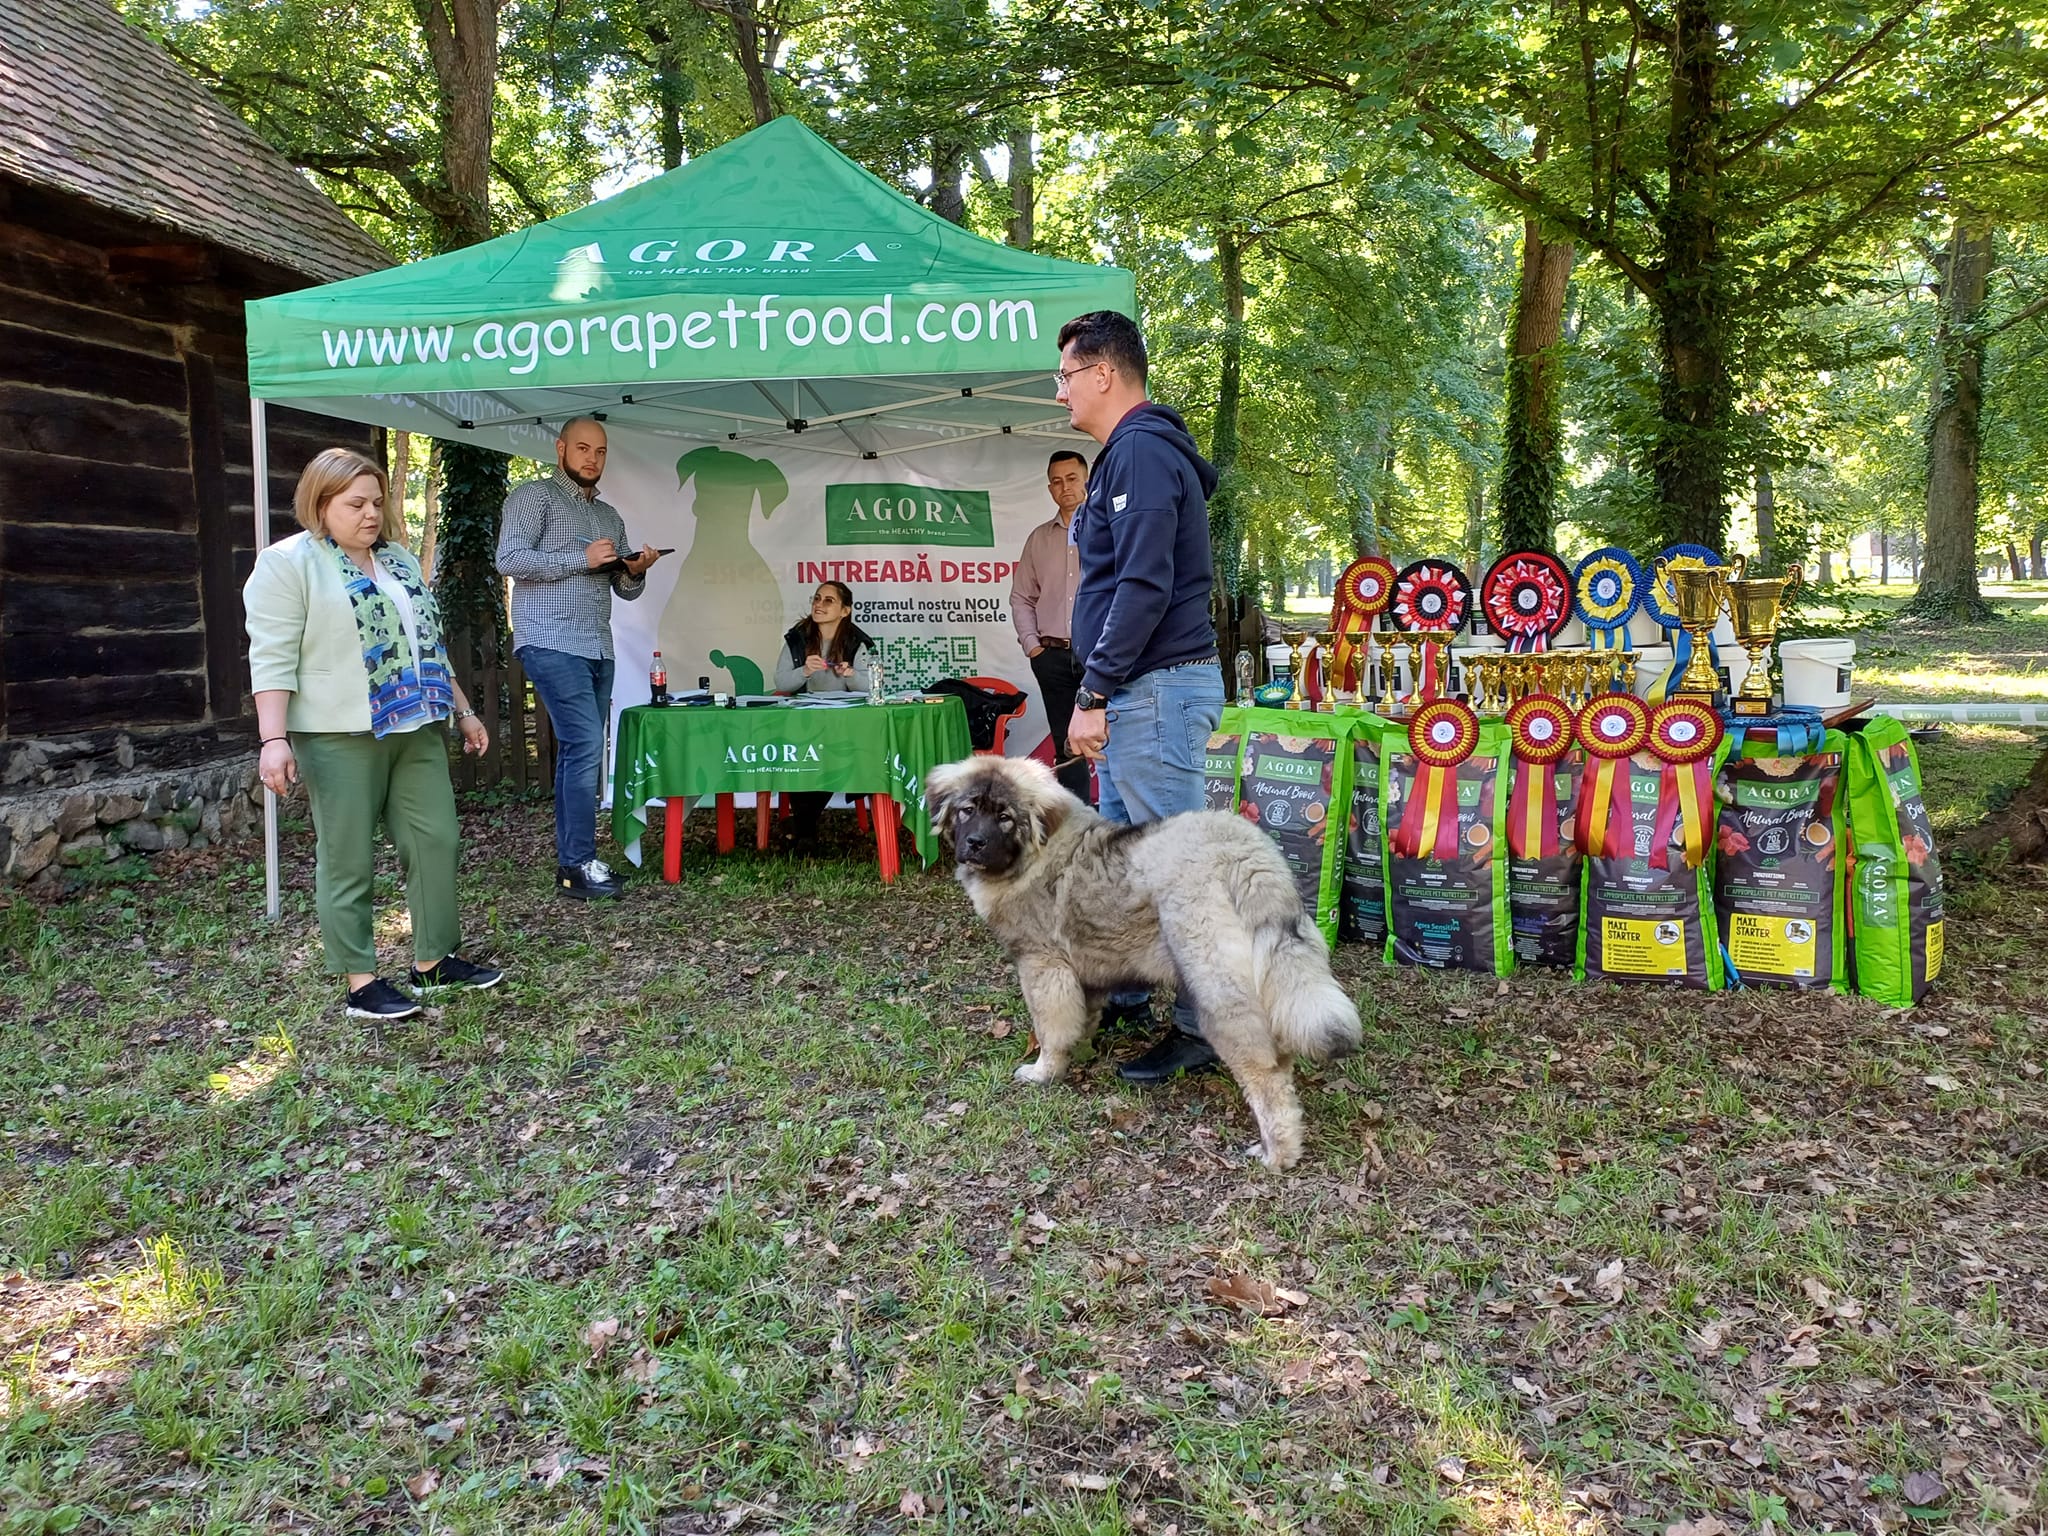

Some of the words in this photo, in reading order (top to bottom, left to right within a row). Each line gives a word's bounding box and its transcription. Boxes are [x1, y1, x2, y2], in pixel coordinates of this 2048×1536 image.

[554, 239, 881, 264] AGORA
[660, 267, 757, 275] HEALTHY
[321, 293, 1039, 374] www.agorapetfood.com
[847, 497, 971, 525] AGORA
[891, 527, 925, 536] HEALTHY
[797, 552, 933, 583] INTREABĂ
[853, 598, 915, 614] ogramul
[918, 599, 961, 611] nostru
[965, 598, 1000, 610] NOU
[854, 611, 925, 623] conectare
[928, 612, 943, 622] cu
[947, 610, 1007, 623] Canisele
[724, 743, 820, 764] AGORA
[1205, 759, 1233, 770] ORA
[1264, 761, 1314, 776] AGORA
[1251, 781, 1293, 797] Natural
[1290, 785, 1318, 801] Boost
[1747, 786, 1811, 799] AGORA
[1738, 810, 1787, 828] Natural
[1785, 808, 1816, 824] Boost
[1872, 852, 1889, 917] AGORA
[1766, 890, 1777, 898] PET
[1777, 891, 1811, 901] NUTRITION
[1607, 920, 1628, 931] MAXI
[1736, 916, 1758, 927] MAXI
[1607, 930, 1641, 941] STARTER
[1735, 926, 1770, 938] STARTER
